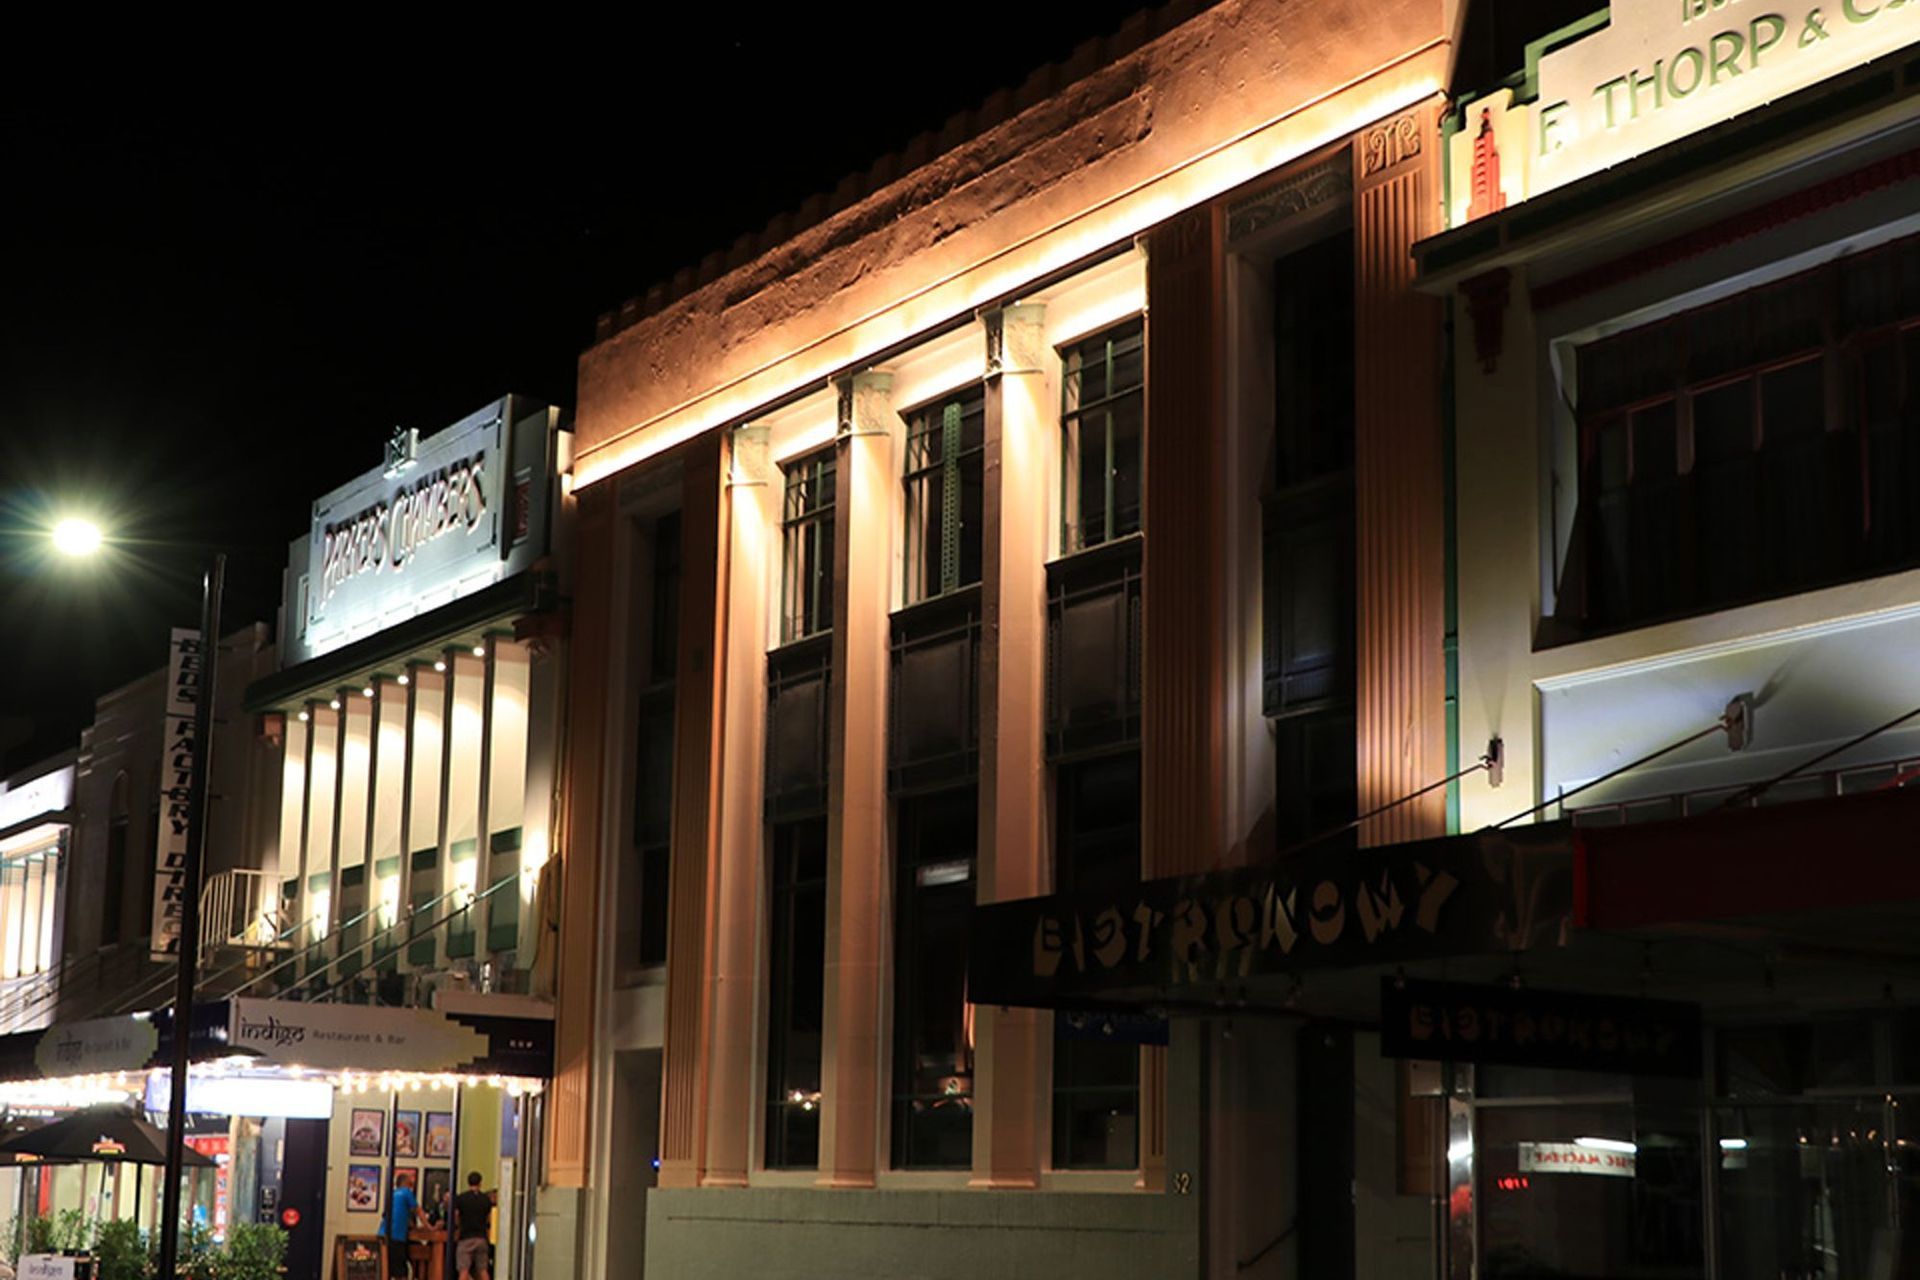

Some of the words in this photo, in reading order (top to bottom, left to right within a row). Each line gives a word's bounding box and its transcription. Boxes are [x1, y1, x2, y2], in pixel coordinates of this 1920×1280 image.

[1539, 100, 1569, 157] F.
[1594, 12, 1785, 130] THORP
[1796, 8, 1831, 49] &
[177, 637, 200, 704] BEDS
[167, 720, 195, 836] FACTORY
[161, 851, 186, 954] DIRECT
[240, 1015, 306, 1048] indigo
[312, 1028, 371, 1043] Restaurant
[387, 1033, 408, 1046] Bar
